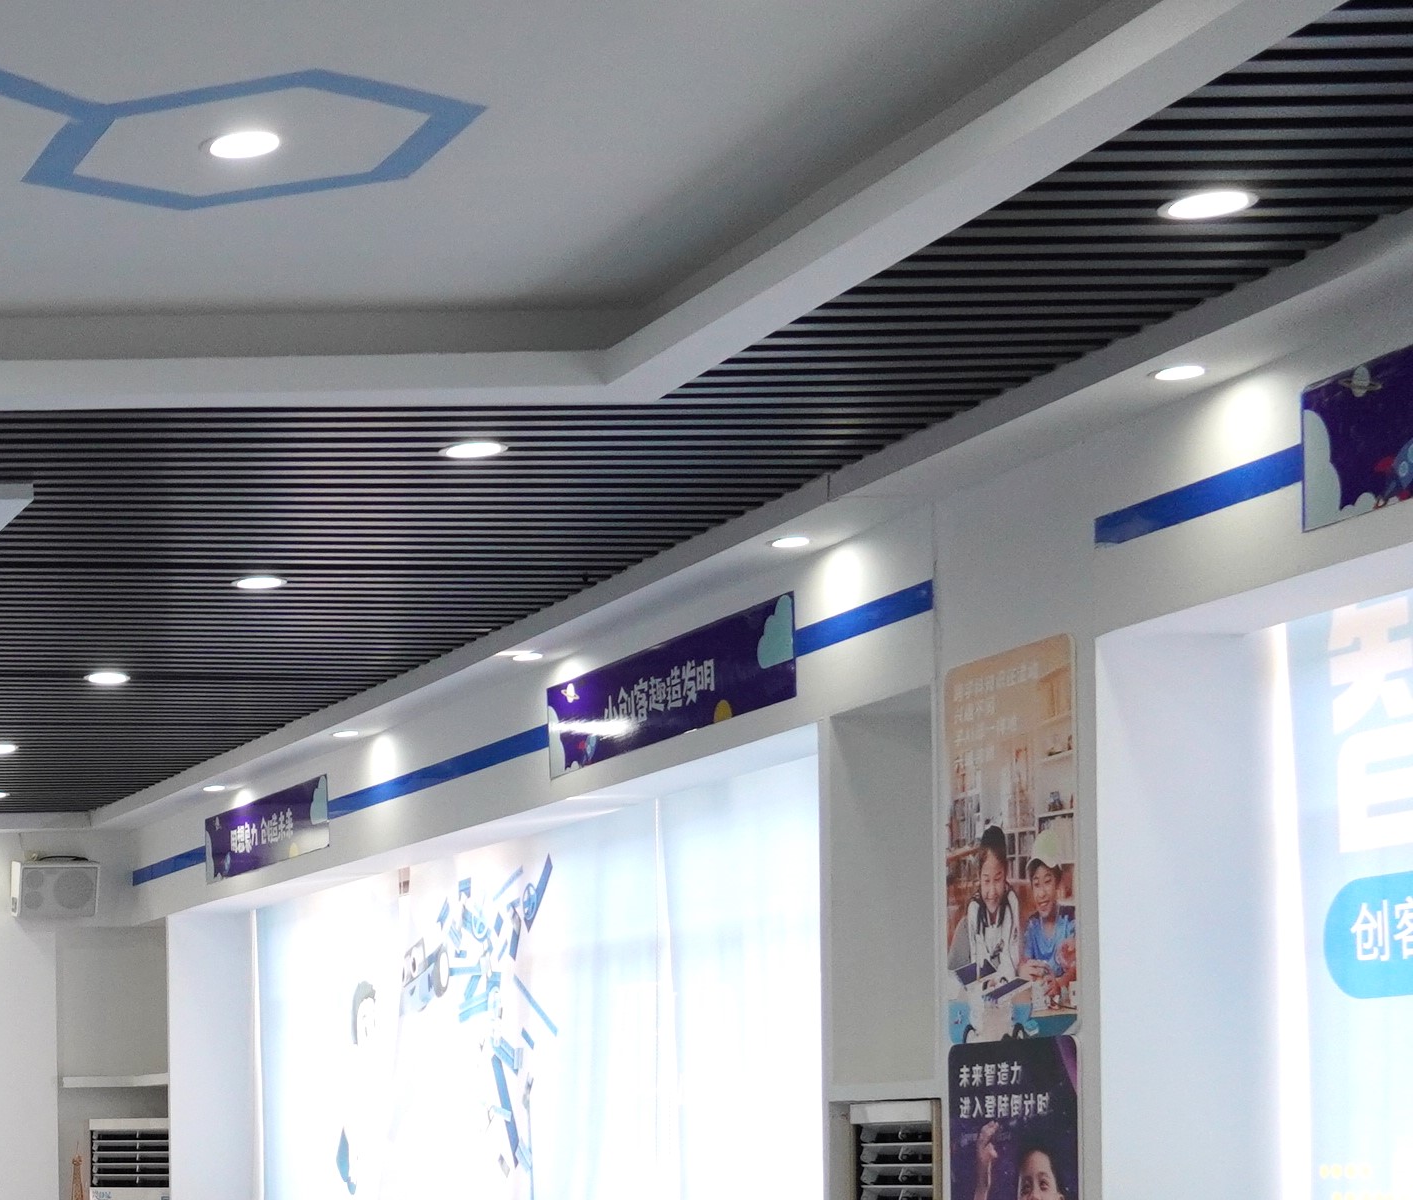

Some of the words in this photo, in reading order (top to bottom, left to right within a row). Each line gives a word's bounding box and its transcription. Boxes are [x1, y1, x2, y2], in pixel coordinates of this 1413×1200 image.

[260, 807, 293, 845] 创造未来
[959, 1061, 1022, 1088] 未来智造力
[959, 1092, 1050, 1119] 进入登陆倒计时
